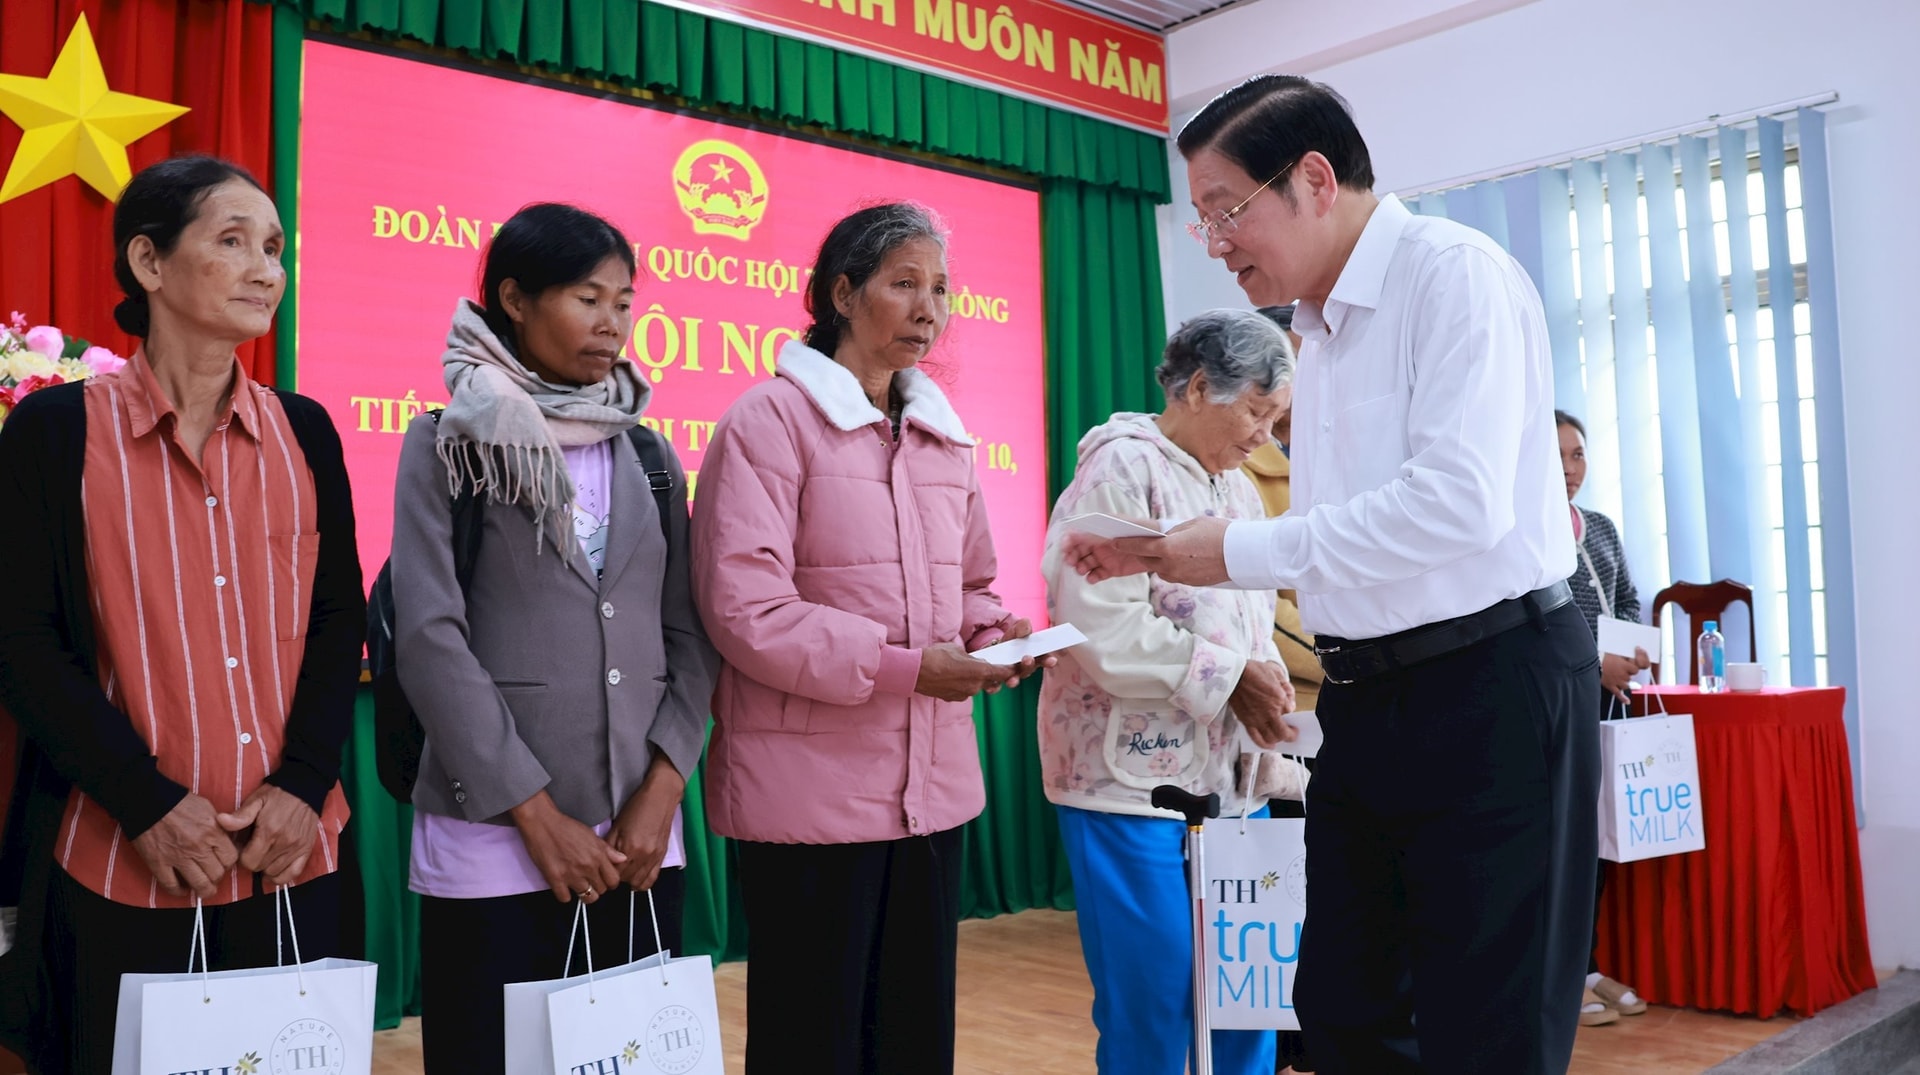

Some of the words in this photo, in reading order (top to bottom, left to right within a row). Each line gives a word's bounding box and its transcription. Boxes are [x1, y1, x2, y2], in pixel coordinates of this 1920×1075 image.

[914, 0, 1055, 72] MUÔN
[1069, 38, 1161, 103] NĂM
[372, 205, 482, 250] ĐOÀN
[744, 259, 800, 298] HỘI
[620, 303, 704, 383] ỘI
[350, 389, 447, 434] TIẾ
[987, 442, 1018, 476] 10,
[1619, 761, 1646, 780] TH
[1625, 782, 1692, 817] true
[1629, 810, 1695, 847] MILK
[1212, 879, 1259, 904] TH
[1213, 909, 1301, 963] tru
[1218, 964, 1296, 1009] MIL
[280, 1023, 333, 1043] NATURE
[651, 1009, 693, 1030] NATURE
[658, 1027, 692, 1052] TH
[287, 1045, 329, 1071] TH
